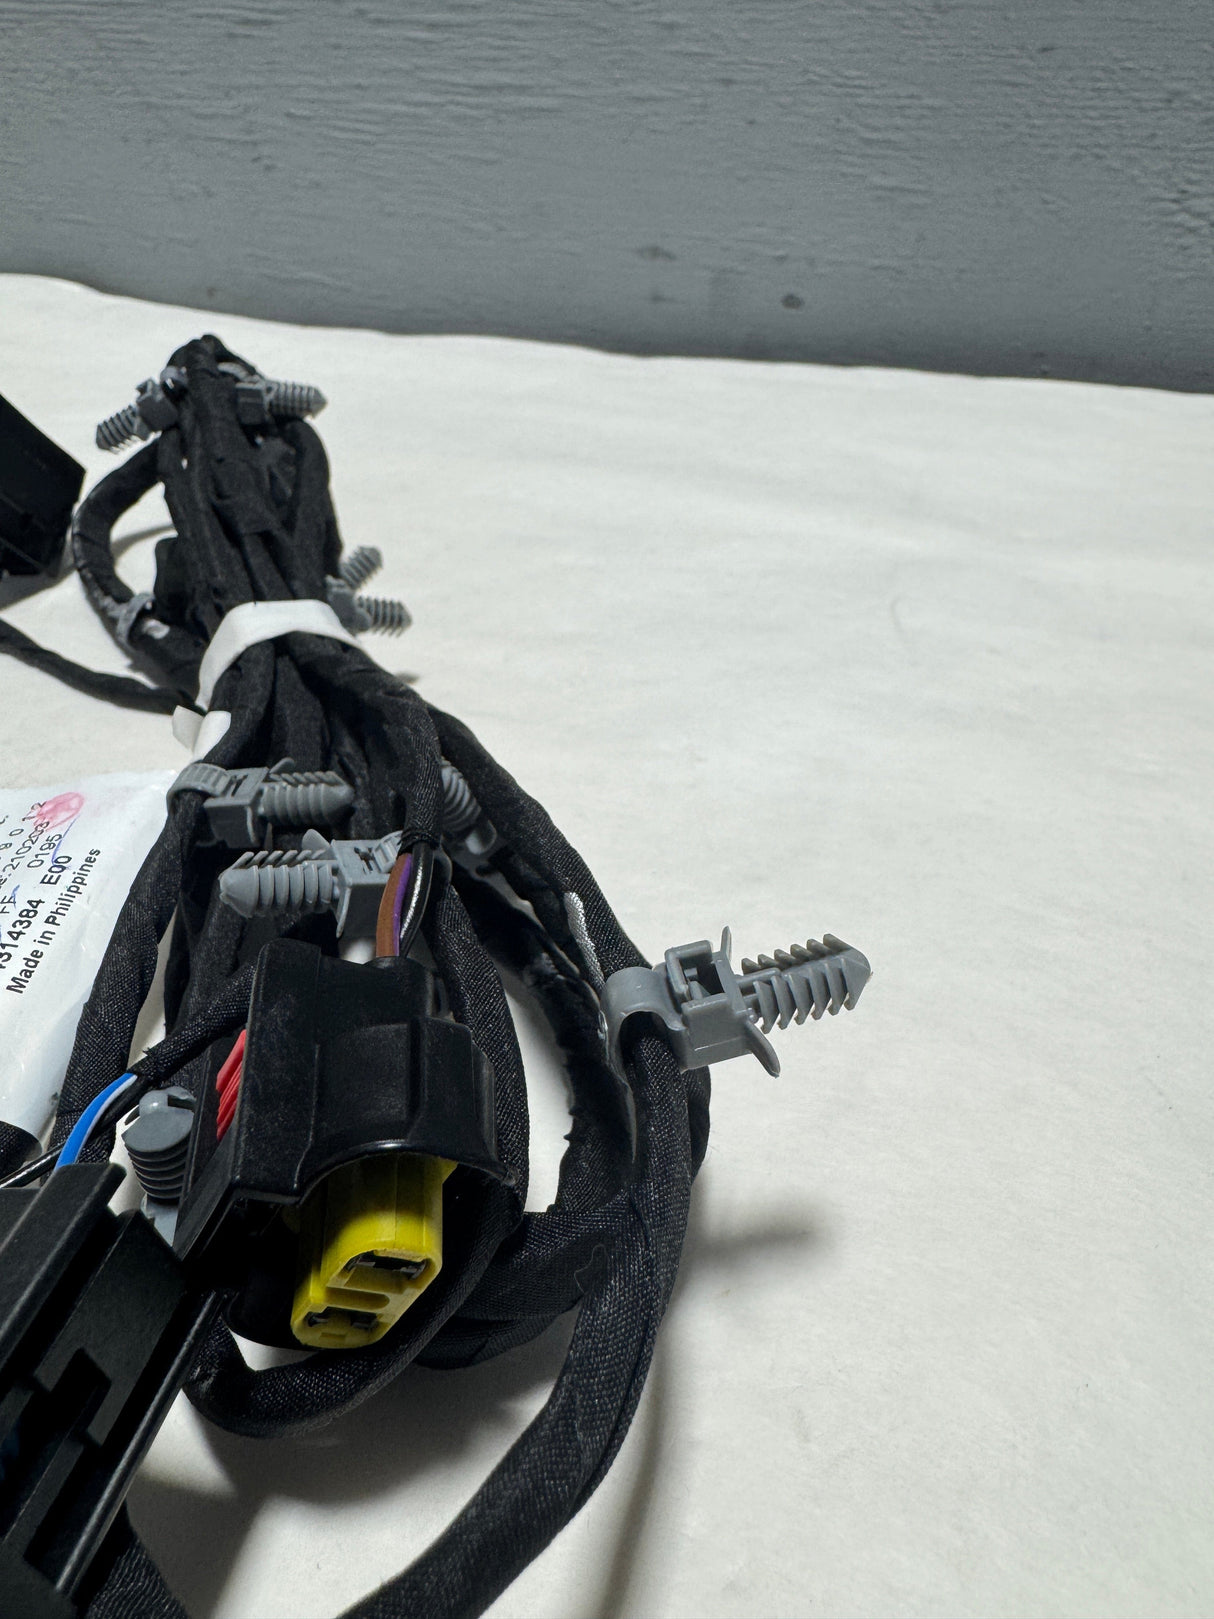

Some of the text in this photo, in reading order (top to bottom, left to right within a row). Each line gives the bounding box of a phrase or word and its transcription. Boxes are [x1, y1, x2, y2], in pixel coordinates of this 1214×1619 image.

[0, 855, 72, 969] 314384 E00
[6, 848, 101, 994] Made in Philippines
